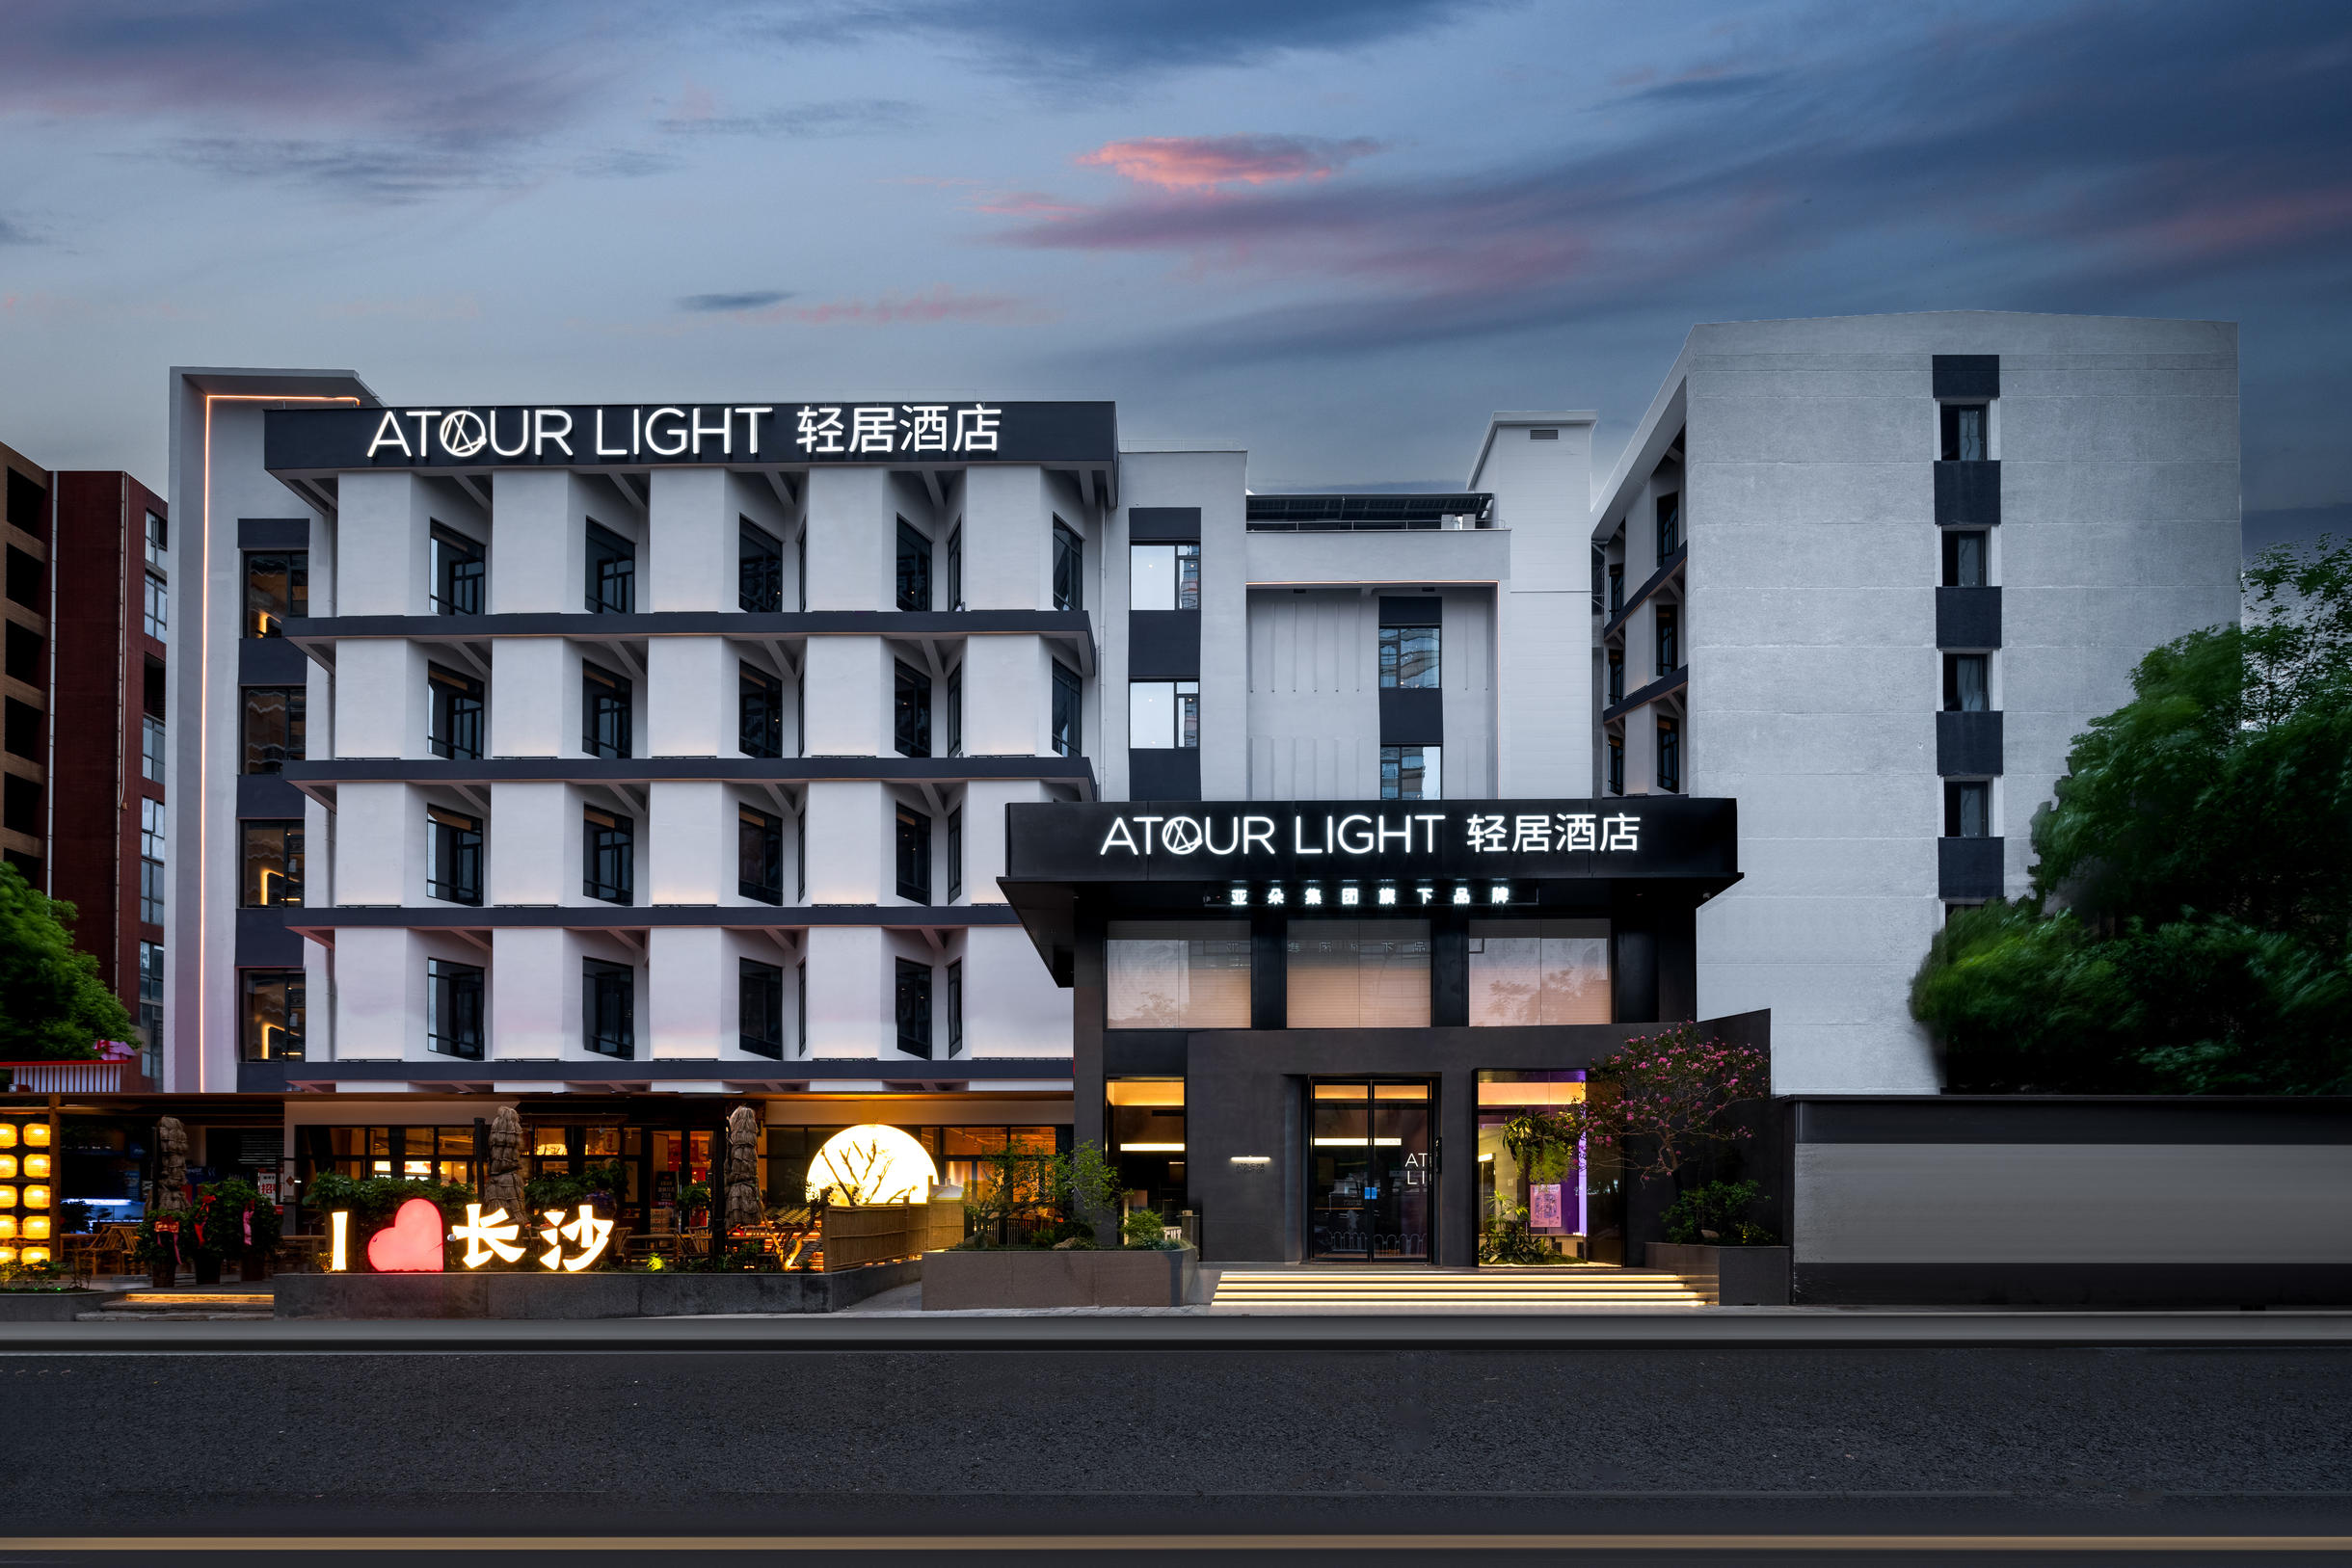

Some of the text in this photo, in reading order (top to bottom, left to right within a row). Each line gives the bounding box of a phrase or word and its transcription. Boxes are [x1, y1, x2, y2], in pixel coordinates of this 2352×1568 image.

[366, 404, 1002, 458] ATOUR LIGHT 轻居酒店
[1100, 812, 1641, 856] ATOUR LIGHT 轻居酒店
[1230, 887, 1510, 906] 亚朵集团旗下品牌
[332, 1203, 615, 1272] I 长沙
